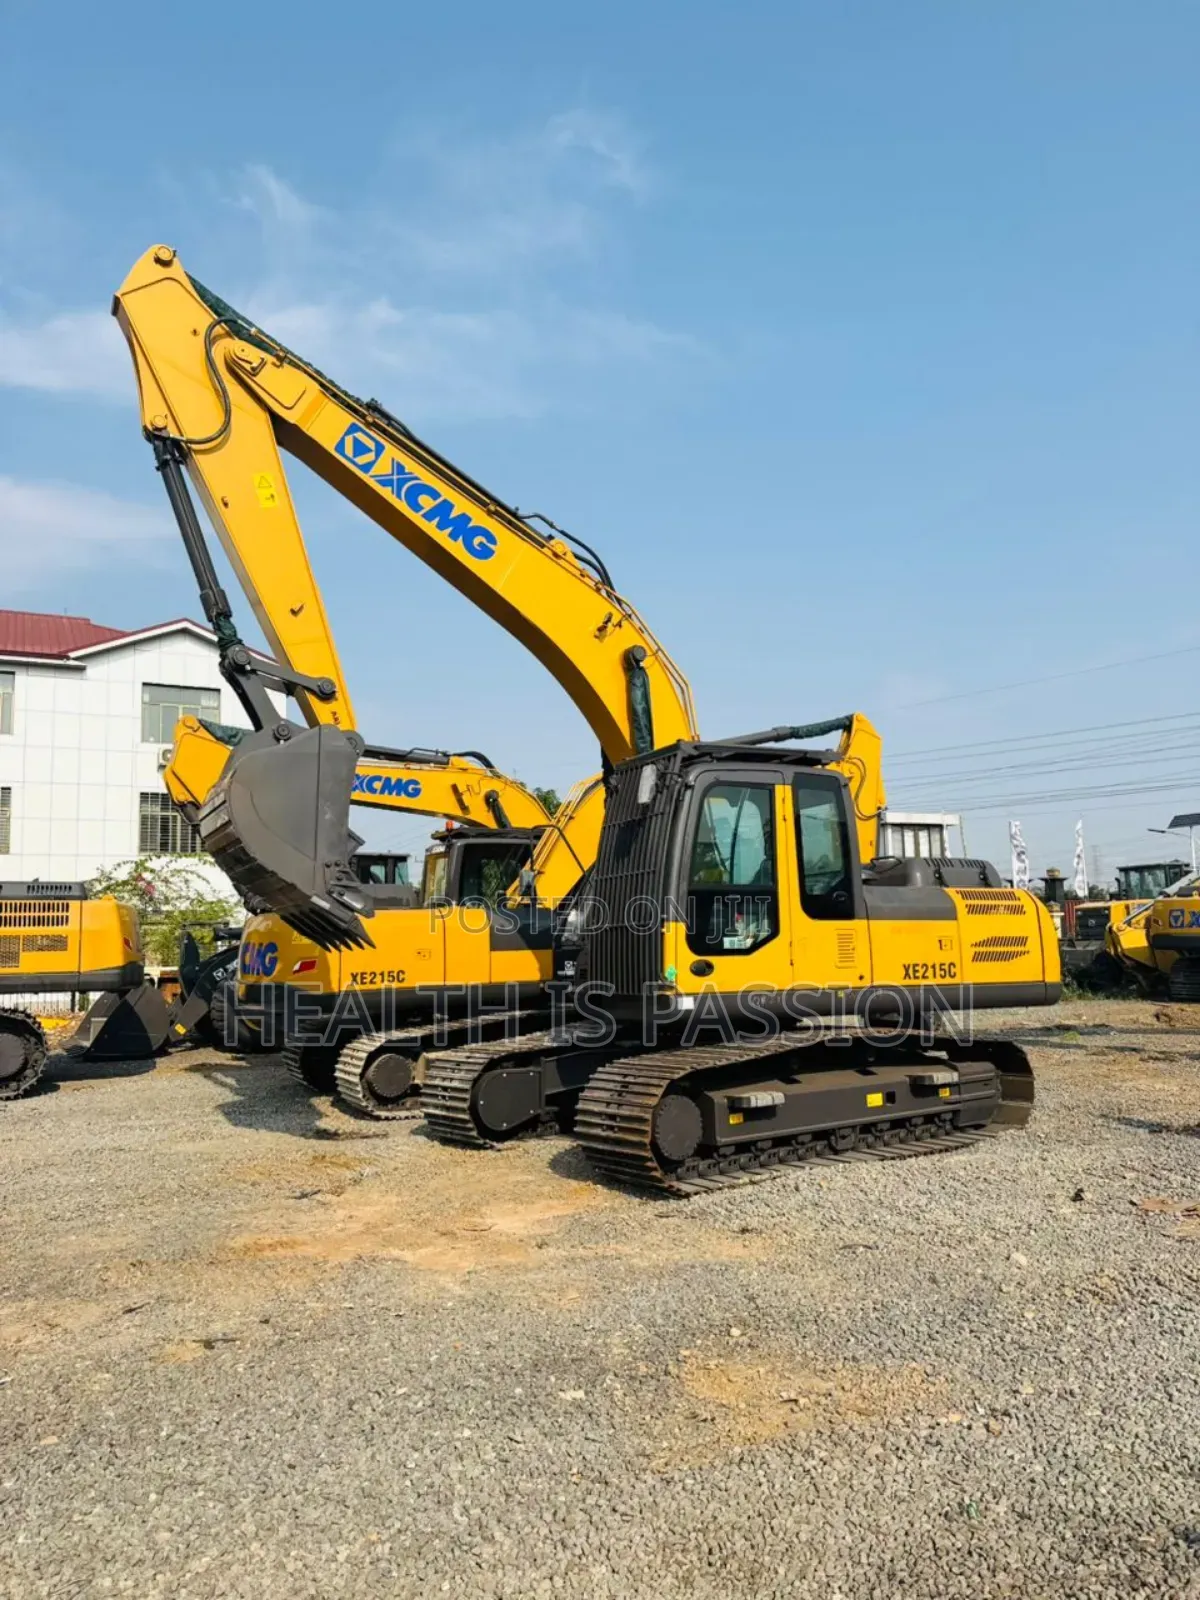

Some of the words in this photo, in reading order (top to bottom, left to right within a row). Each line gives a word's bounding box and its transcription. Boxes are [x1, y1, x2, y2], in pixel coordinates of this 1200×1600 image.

[369, 457, 498, 560] XCMG
[351, 774, 422, 798] XCMG
[350, 969, 406, 985] XE215C
[902, 962, 957, 980] XE215C
